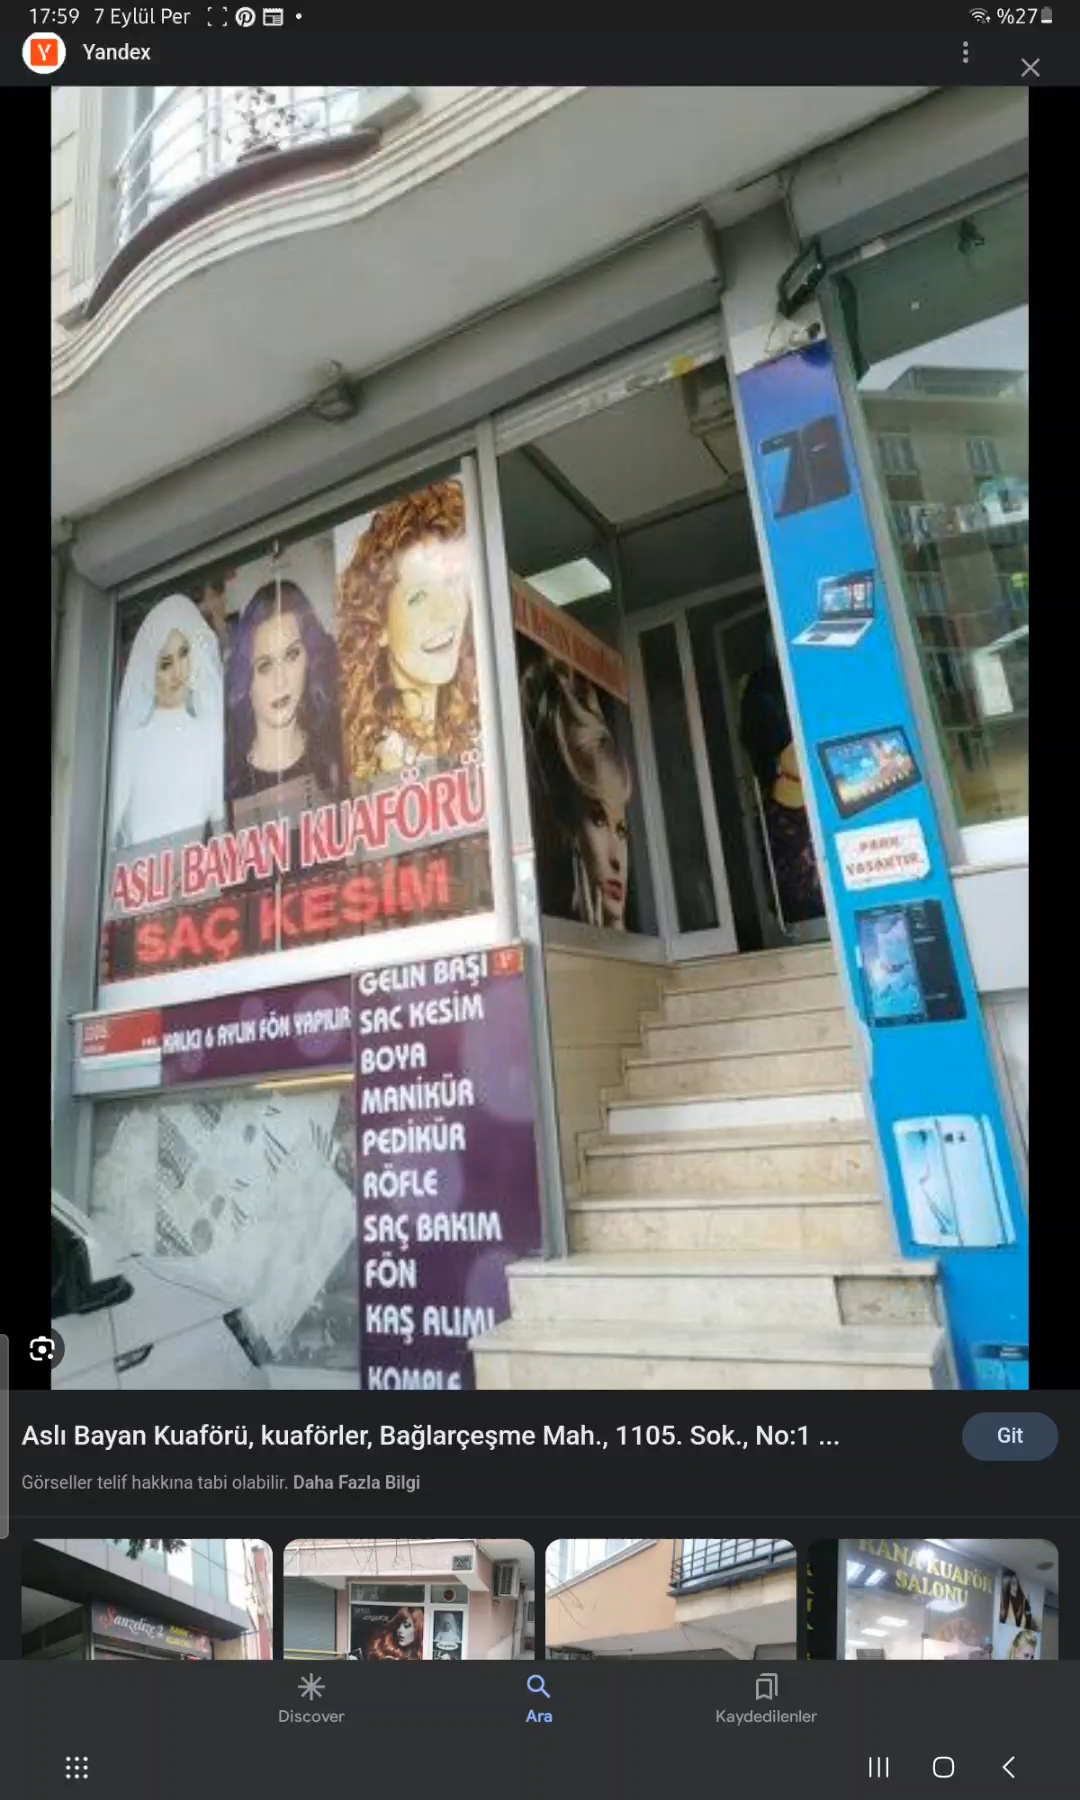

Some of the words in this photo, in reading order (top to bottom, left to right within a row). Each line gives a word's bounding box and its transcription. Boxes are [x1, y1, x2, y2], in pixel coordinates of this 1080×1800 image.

[110, 850, 173, 913] ASLI
[181, 816, 291, 897] BAYAN
[300, 750, 489, 866] KUAFÖRÜ
[135, 906, 240, 963] SAÇ
[434, 952, 487, 987] BAŞI
[408, 990, 484, 1029] KESİM
[204, 1027, 214, 1048] 6
[259, 1011, 289, 1039] FÖN
[361, 1042, 427, 1075] BOYA
[361, 1073, 474, 1114] MANİKÜR
[362, 1117, 466, 1156] PEDİKÜR
[363, 1162, 438, 1199] RÖFLE
[364, 1214, 409, 1251] SAÇ
[416, 1211, 503, 1241] BAKIM
[364, 1251, 417, 1288] FÖN
[366, 1303, 415, 1345] KAŞ
[895, 1569, 969, 1607] SALONU
